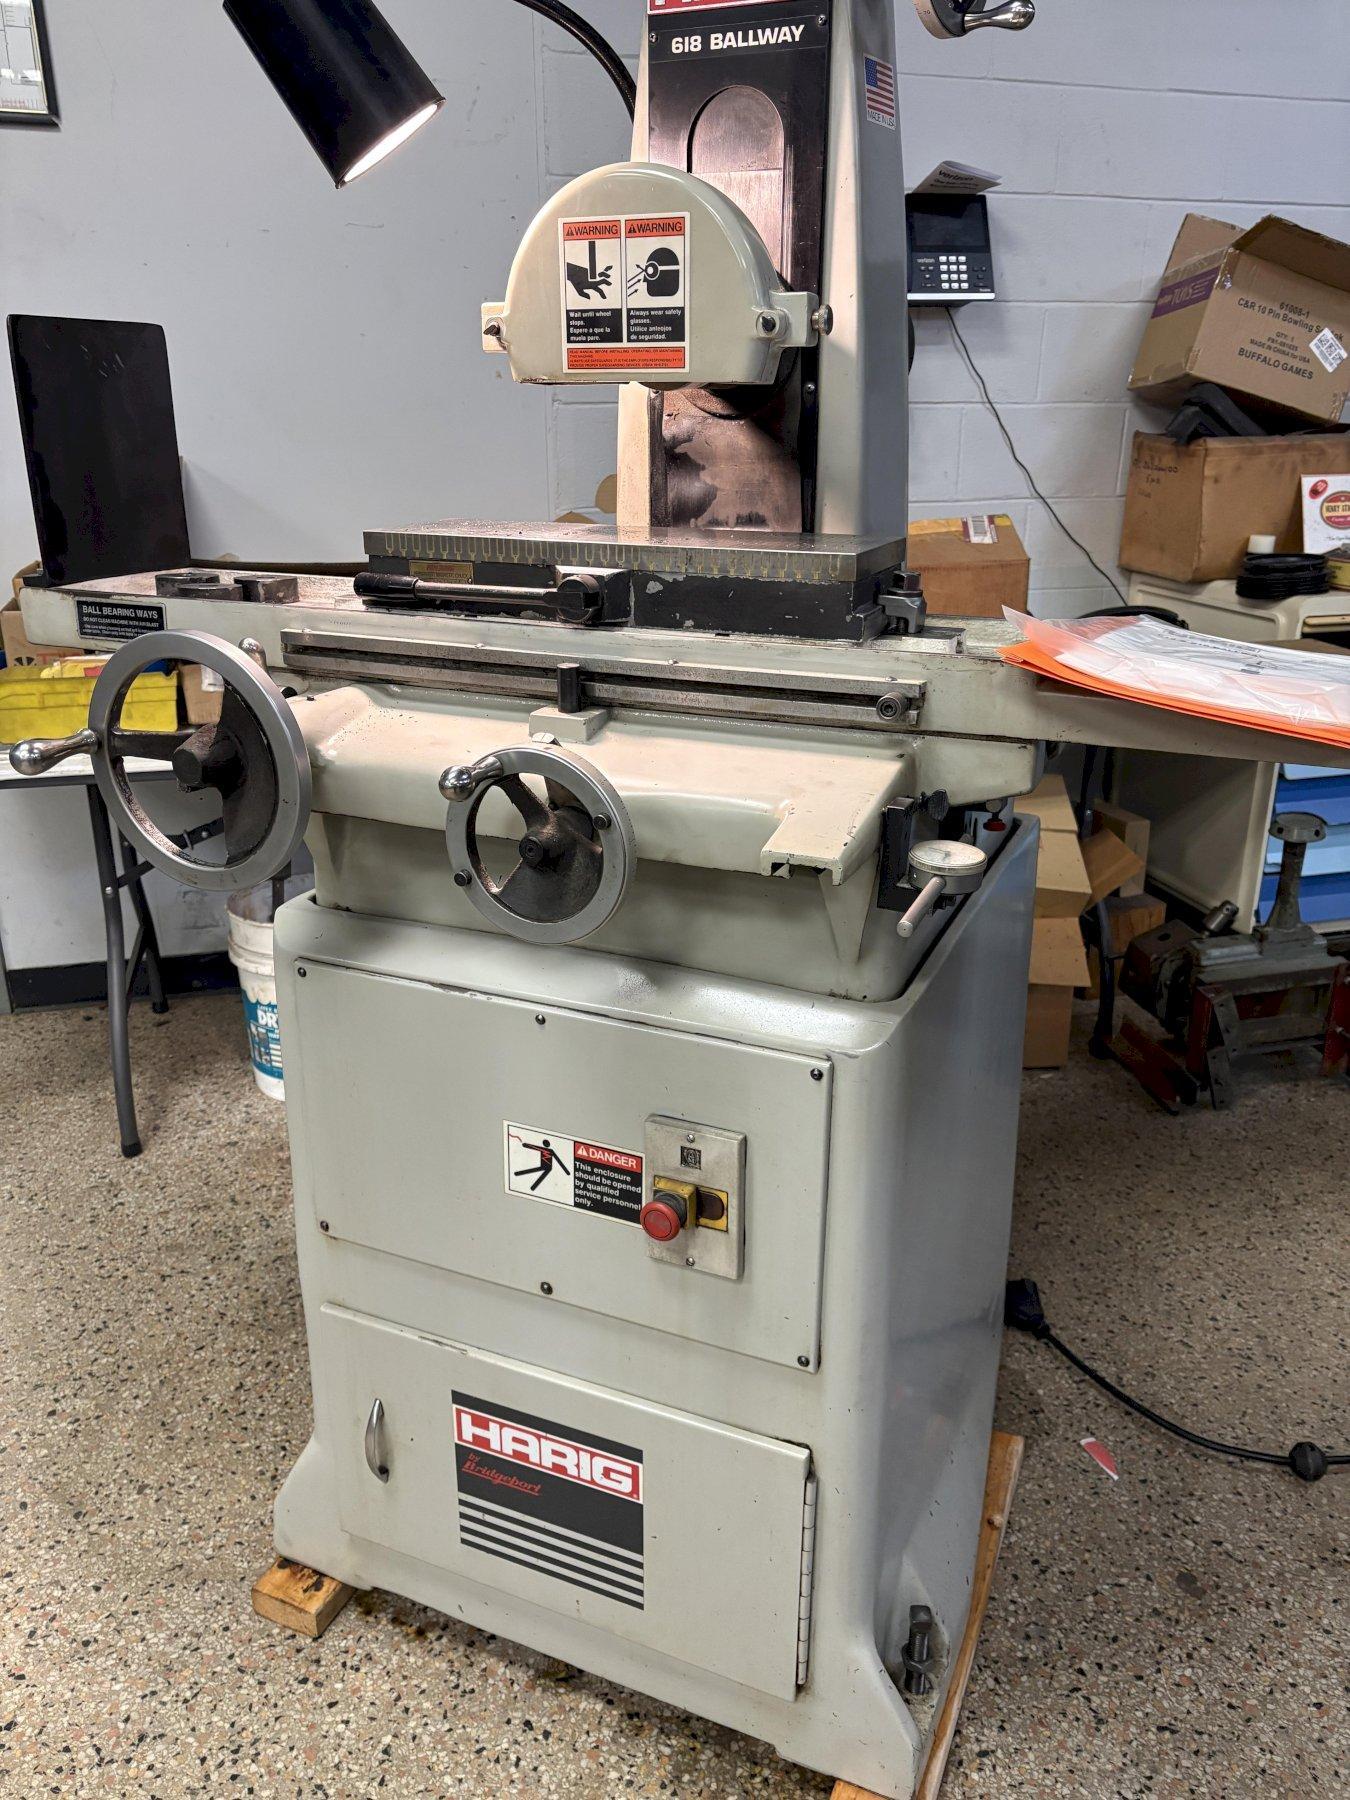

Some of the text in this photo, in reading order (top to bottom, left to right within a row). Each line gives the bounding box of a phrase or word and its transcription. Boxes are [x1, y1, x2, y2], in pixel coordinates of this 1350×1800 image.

[671, 25, 805, 53] 618 BALLWAY
[574, 224, 619, 236] WARNING
[637, 221, 683, 233] WARNING
[1238, 298, 1256, 311] C&R
[1268, 308, 1281, 319] Pin
[1282, 313, 1314, 332] Bowling
[1238, 347, 1314, 379] BUFFALO GAMES
[82, 605, 158, 619] BALL BEARING WAYS
[589, 1148, 637, 1169] DANGER
[575, 1161, 631, 1182] This enclosure
[575, 1171, 642, 1194] should be opened
[575, 1179, 619, 1196] by qualified
[575, 1188, 641, 1211] service personnel
[575, 1197, 594, 1207] only.
[460, 1412, 633, 1494] HARIG
[468, 1453, 481, 1464] by
[462, 1459, 542, 1492] Bridgeport
